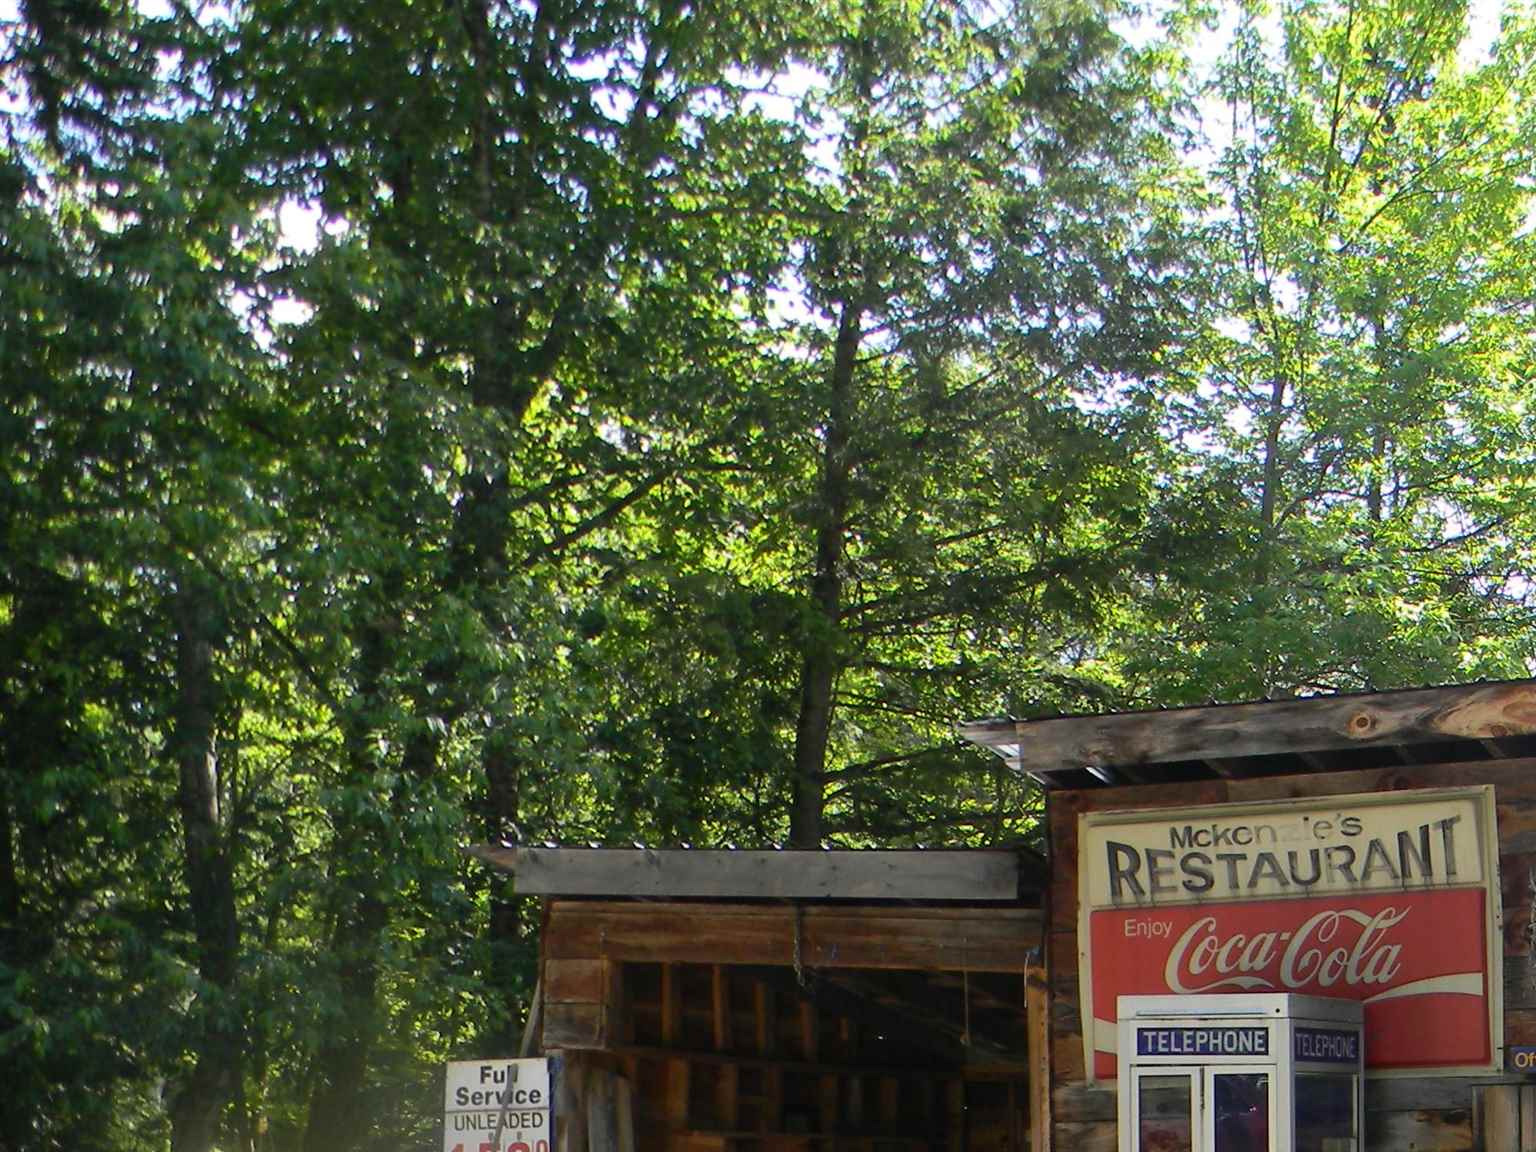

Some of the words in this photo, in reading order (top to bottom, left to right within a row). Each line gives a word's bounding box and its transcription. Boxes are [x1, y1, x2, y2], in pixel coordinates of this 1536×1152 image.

[1105, 814, 1461, 899] RESTAURANT
[1124, 918, 1173, 938] Enjoy
[1164, 905, 1413, 994] Coca-Cola
[1143, 1029, 1266, 1053] TELEPHONE
[1295, 1032, 1356, 1058] TELEPHONE
[480, 1064, 519, 1084] Fu
[456, 1086, 542, 1107] Servce
